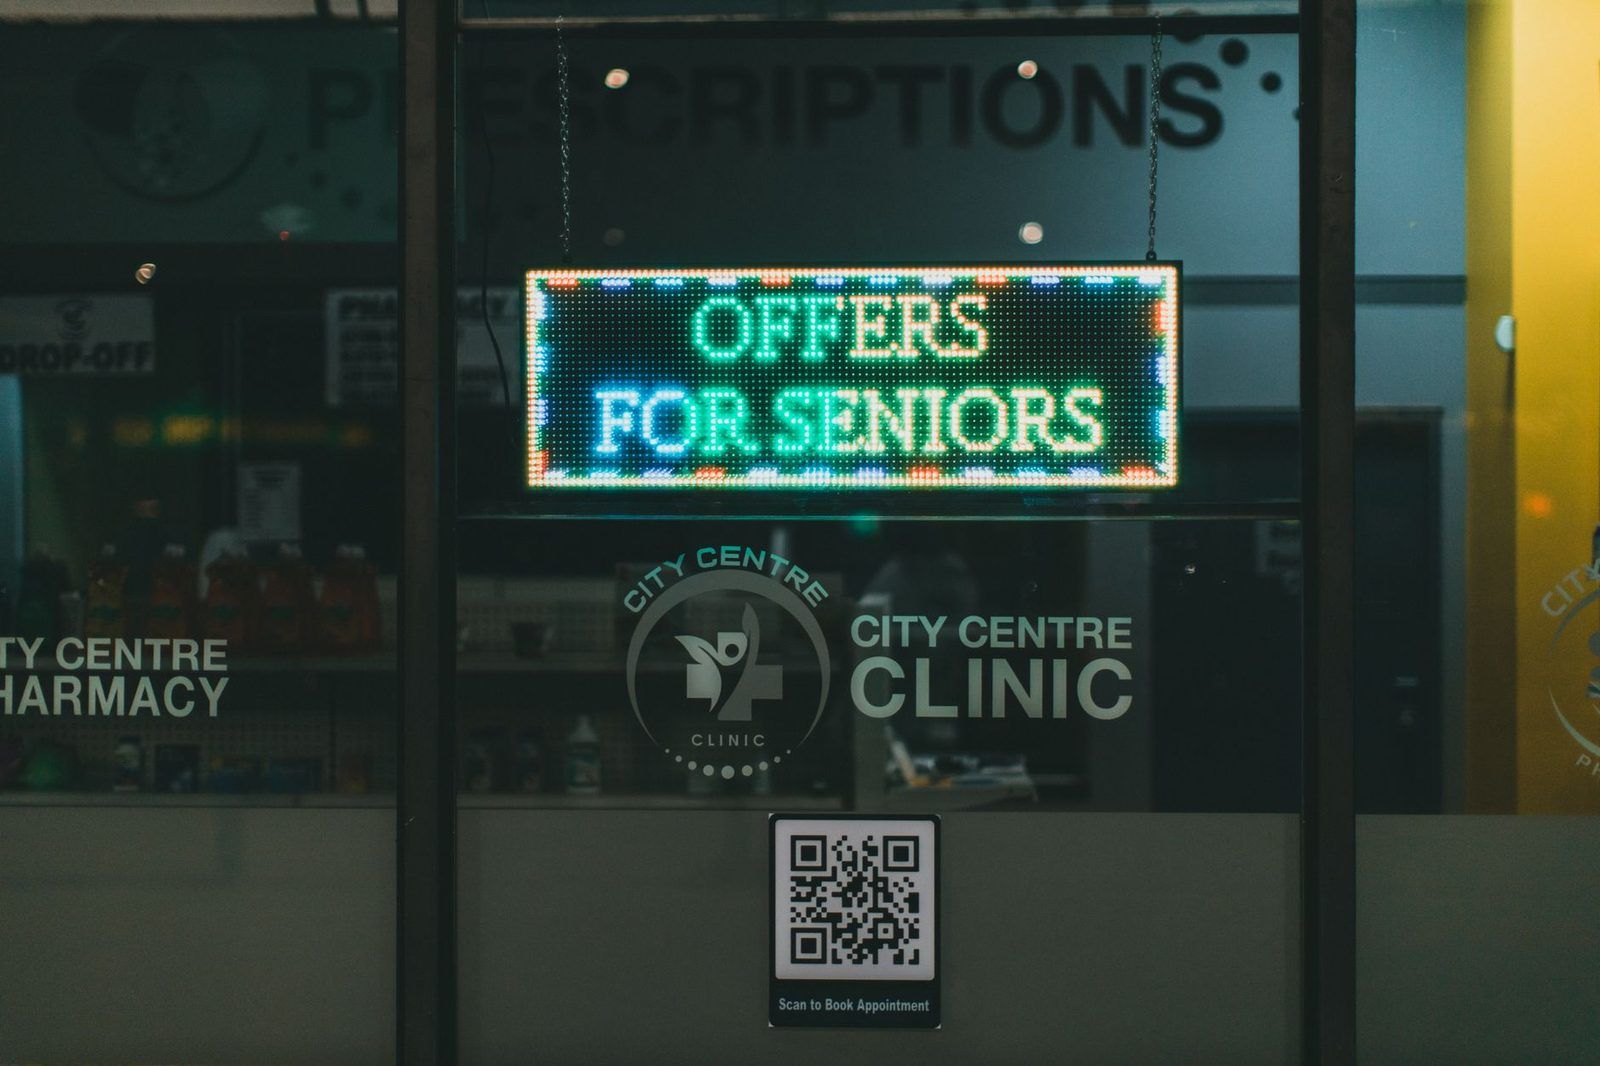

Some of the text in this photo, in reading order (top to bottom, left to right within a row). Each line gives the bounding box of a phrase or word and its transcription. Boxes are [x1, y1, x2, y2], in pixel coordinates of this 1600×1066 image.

[308, 63, 1224, 149] PESCRIPTIONS
[692, 294, 990, 362] OFFERS
[594, 386, 1105, 455] FOR SENIORS
[624, 545, 830, 613] CITY CENTRE
[55, 636, 228, 672] CENTRE
[850, 614, 1133, 650] CITY CENTRE
[850, 656, 1133, 720] CLINIC
[691, 733, 766, 748] CLINIC
[778, 997, 930, 1014] Scan to Book Appointment
